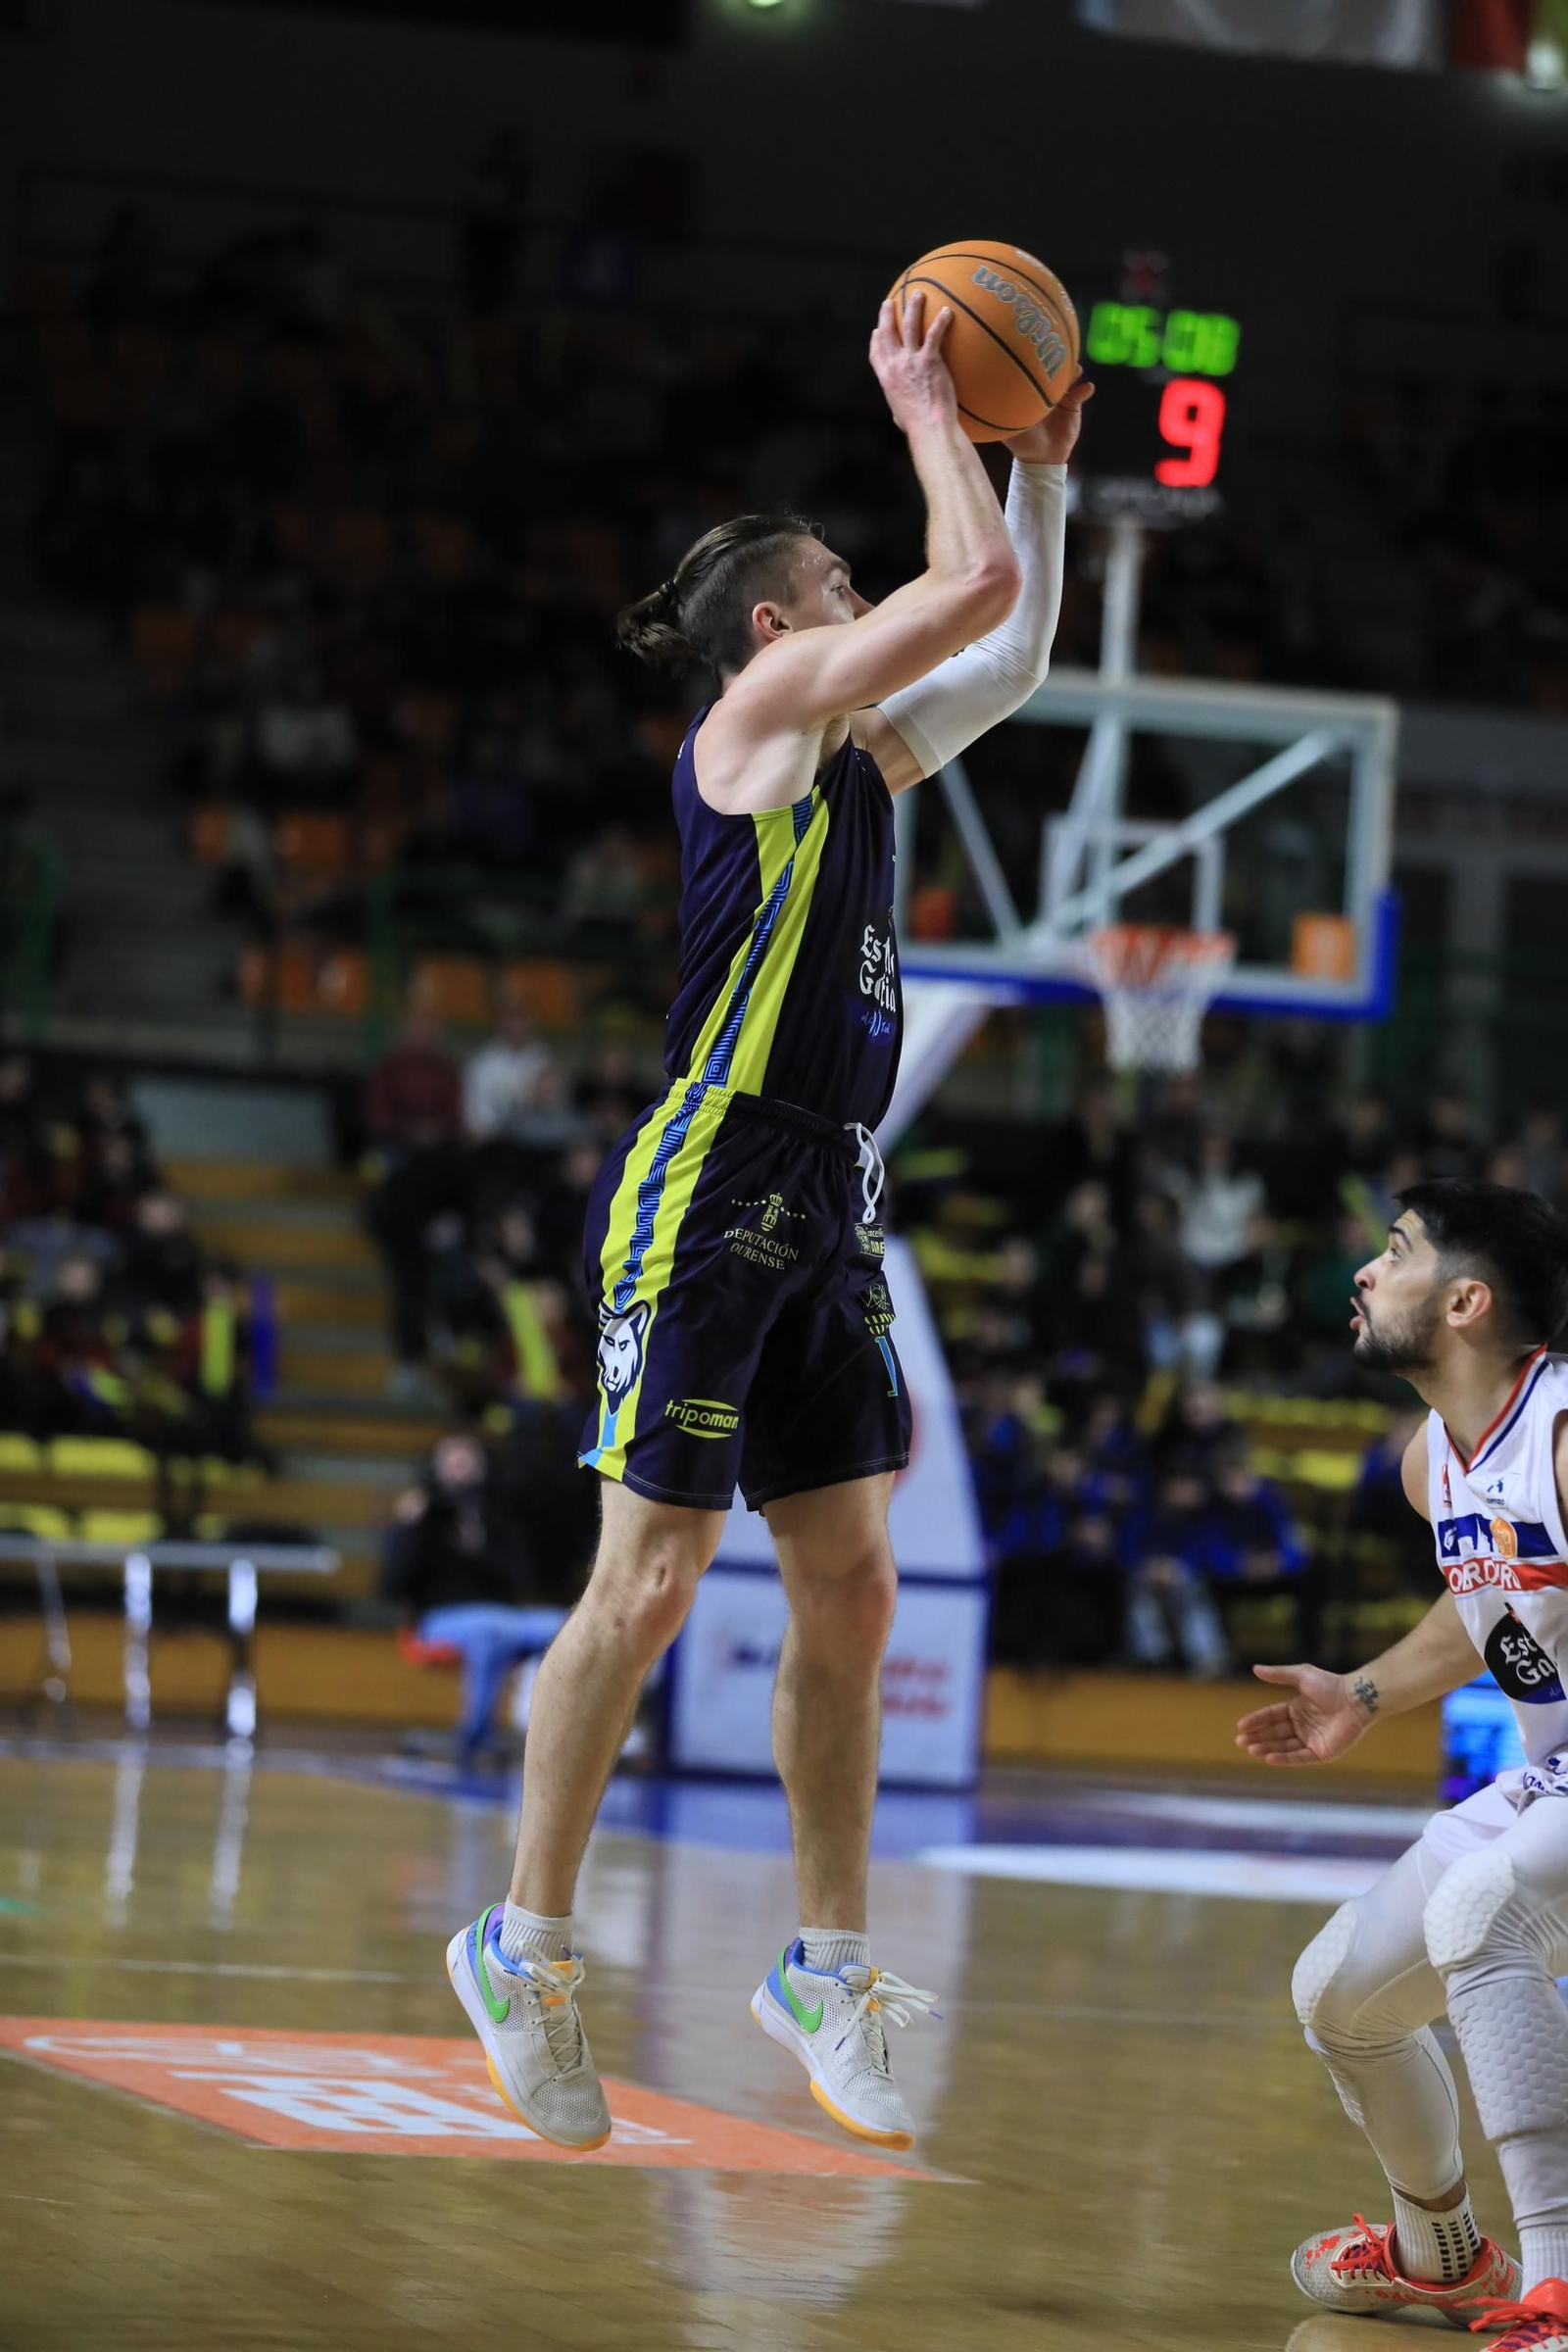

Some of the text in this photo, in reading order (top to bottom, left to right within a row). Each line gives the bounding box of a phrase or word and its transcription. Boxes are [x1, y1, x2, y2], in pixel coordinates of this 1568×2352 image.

[971, 265, 1066, 381] Wilson
[1154, 378, 1226, 487] 9
[724, 1228, 800, 1260] DEPUTACIÓN
[730, 1243, 785, 1269] OURENSE
[664, 1399, 739, 1429] tripoman
